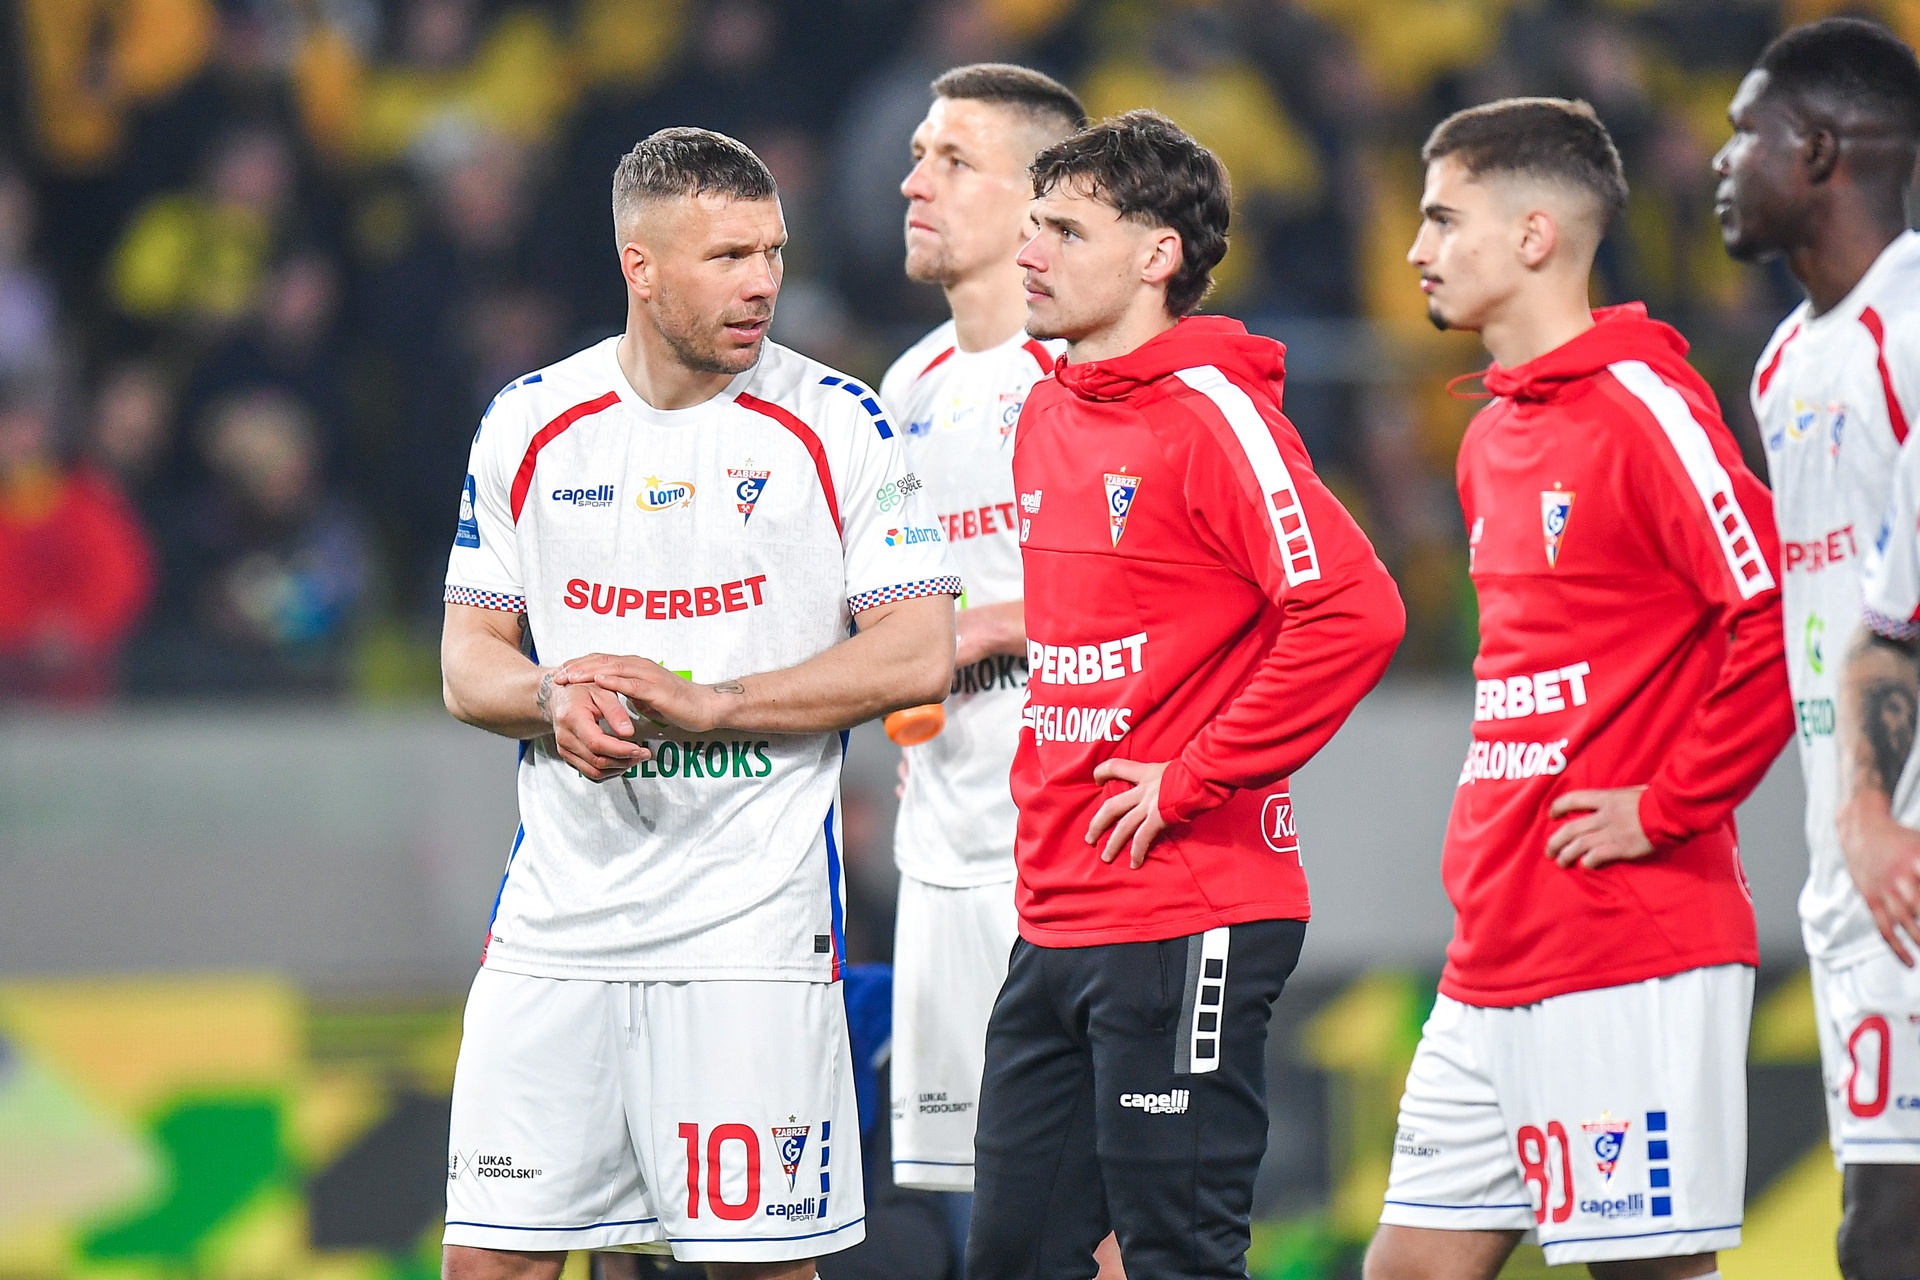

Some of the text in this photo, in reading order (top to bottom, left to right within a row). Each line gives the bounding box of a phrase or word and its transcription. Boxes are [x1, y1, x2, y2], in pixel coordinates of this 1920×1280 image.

[729, 469, 768, 479] ZABRZE
[1106, 476, 1138, 488] ZABRZE
[552, 485, 614, 505] capelli
[650, 487, 685, 506] LOTTO
[903, 526, 942, 545] Zabrze
[563, 574, 767, 620] SUPERBET
[1026, 631, 1149, 685] PERBET
[1475, 661, 1591, 721] ERBET
[1022, 704, 1133, 746] ĘGLOKOKS
[1120, 1089, 1191, 1112] capelli
[1150, 1106, 1188, 1114] SPORT
[775, 1127, 808, 1137] ZABRZE
[478, 1155, 512, 1166] LUKAS
[678, 1122, 761, 1221] 10
[766, 1197, 815, 1220] capelli
[1580, 1193, 1644, 1219] capelli
[790, 1214, 815, 1222] SPORT
